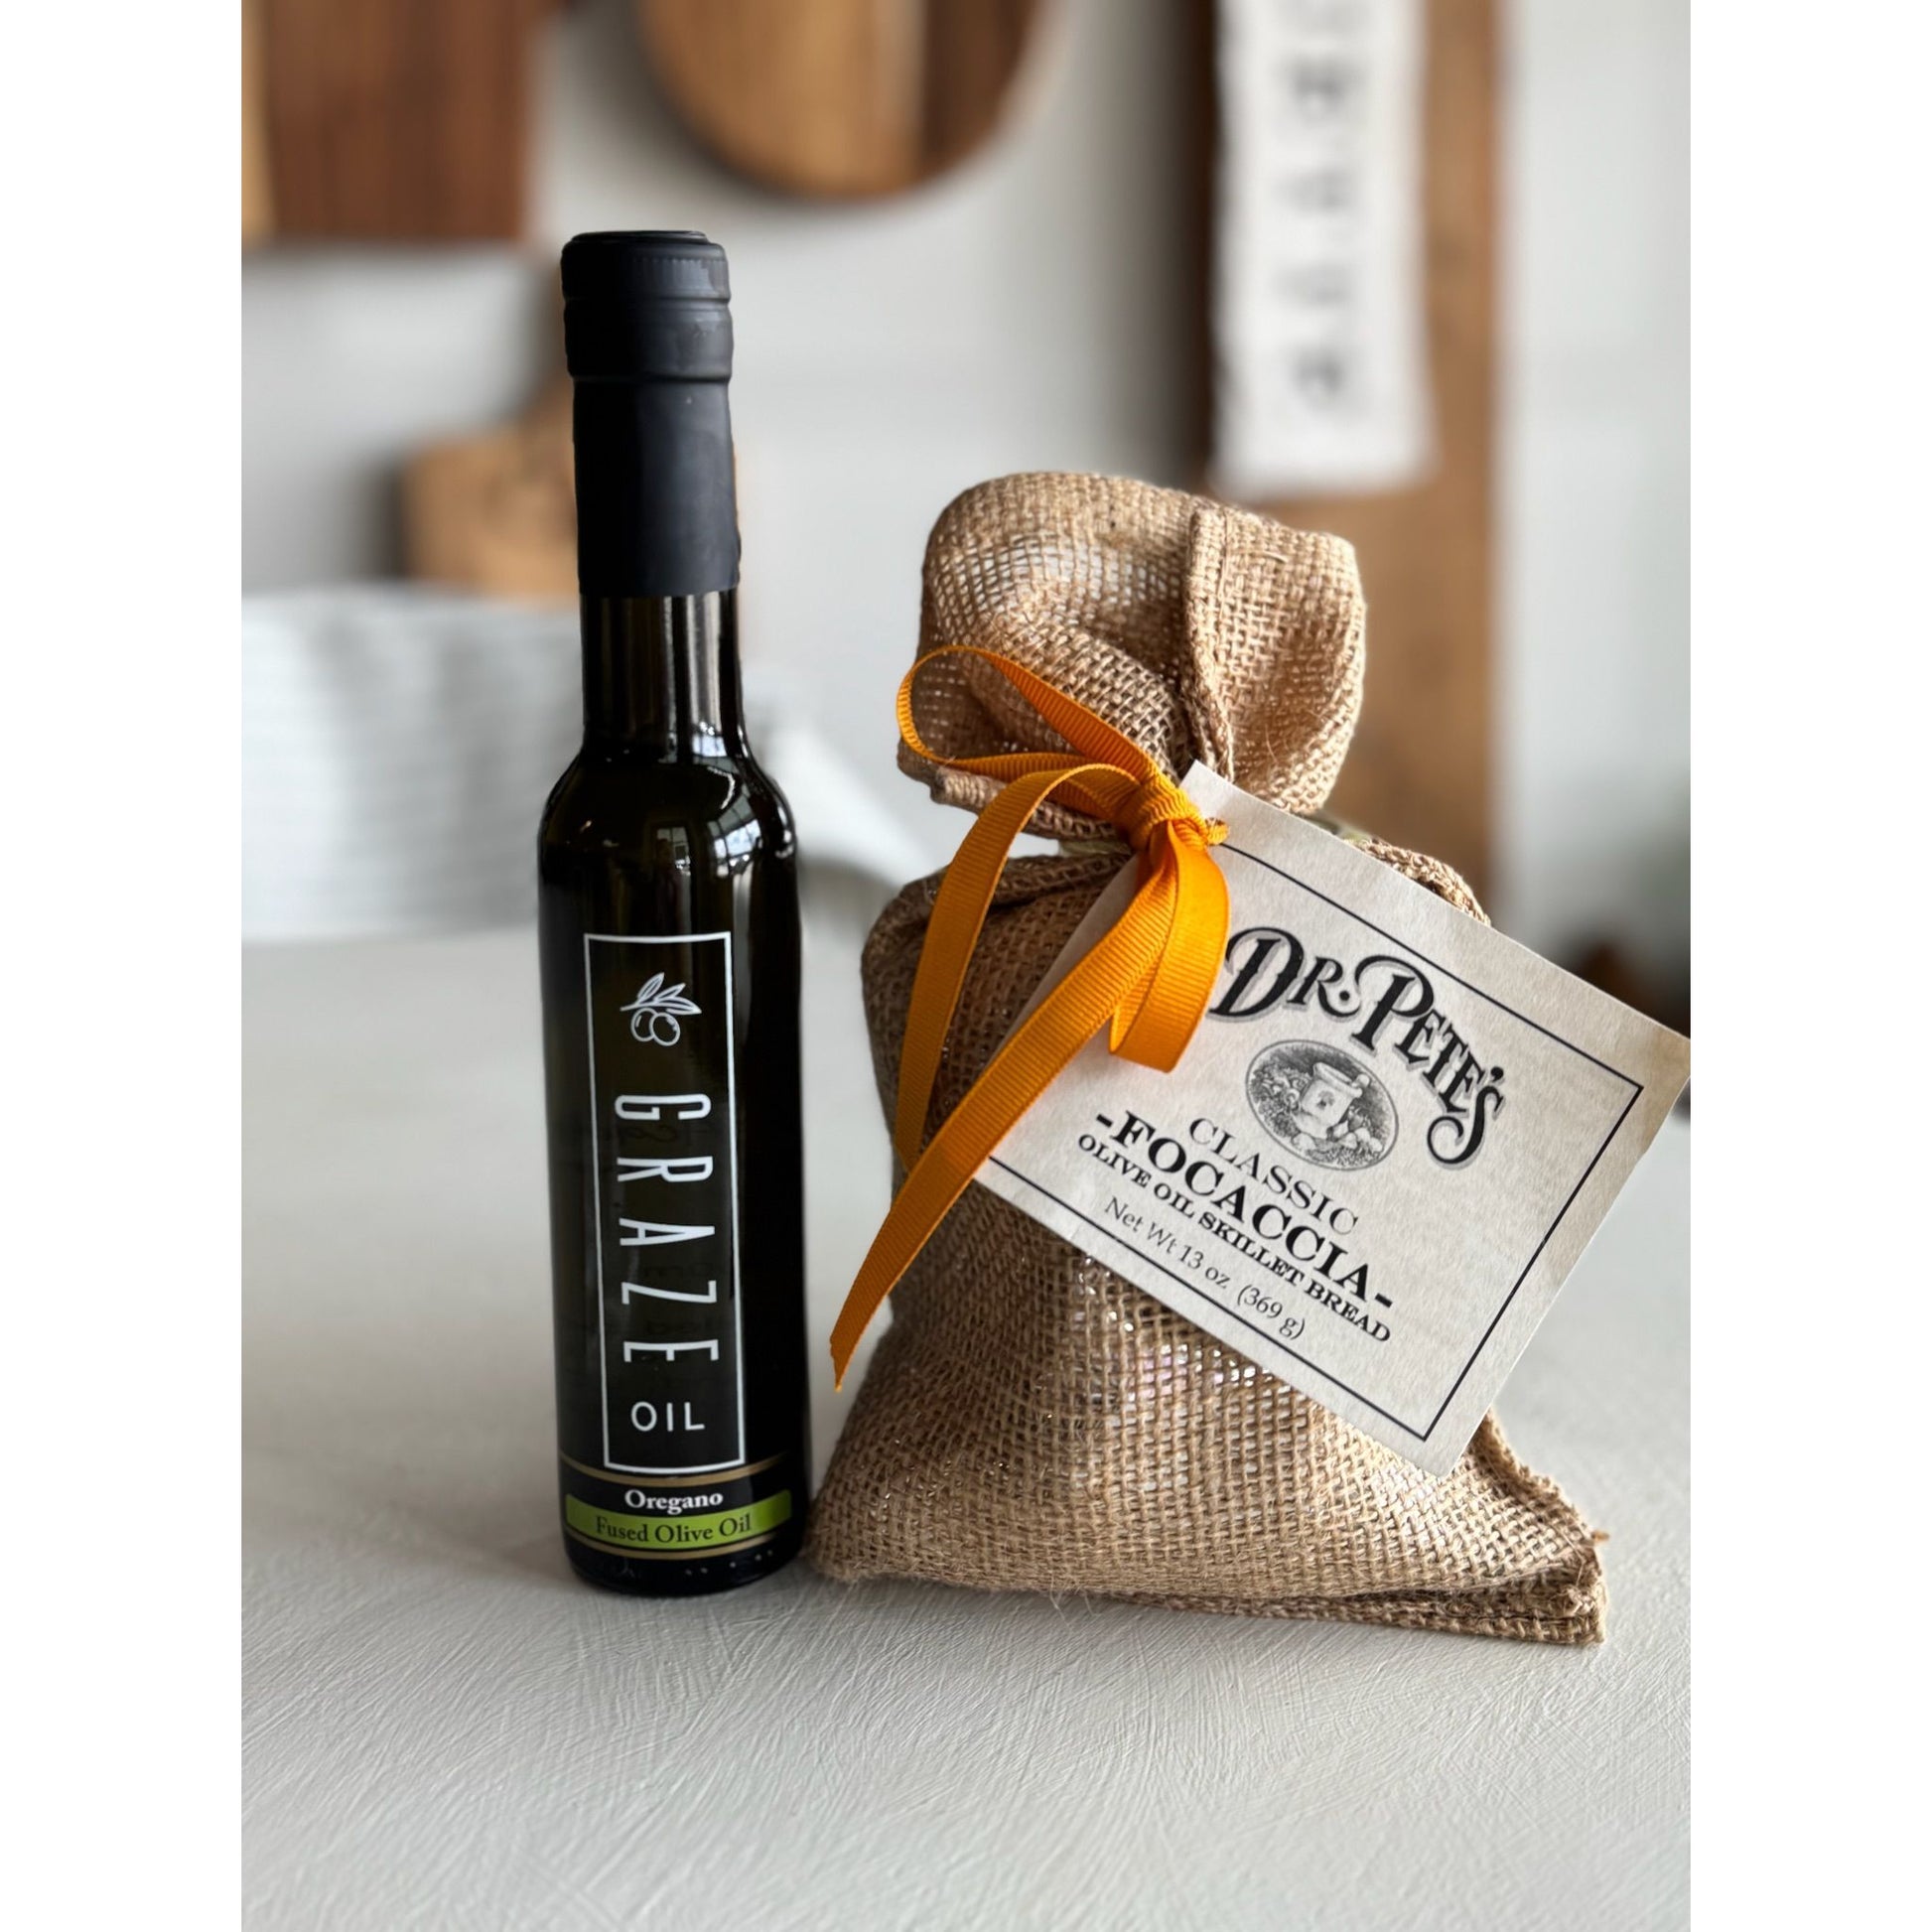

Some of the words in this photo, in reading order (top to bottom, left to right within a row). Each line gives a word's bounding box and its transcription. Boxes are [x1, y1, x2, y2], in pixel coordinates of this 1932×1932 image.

[613, 1093, 720, 1363] GRAZE
[1189, 1118, 1358, 1235] CLASSIC
[1078, 1134, 1152, 1188] OLIVE
[1154, 1182, 1195, 1218] OIL
[1197, 1211, 1305, 1287] SKILLET
[1305, 1279, 1391, 1341] BREAD
[1104, 1195, 1144, 1232] Net
[1147, 1222, 1176, 1254] Wt
[1178, 1244, 1204, 1270] 13
[1204, 1267, 1231, 1289] oz
[1237, 1284, 1283, 1318] (369
[1279, 1316, 1305, 1340] g)
[630, 1401, 705, 1432] OIL
[597, 1516, 648, 1542] Fused
[654, 1525, 714, 1543] Olive
[719, 1513, 752, 1537] Oil
[624, 1489, 724, 1515] Oregano
